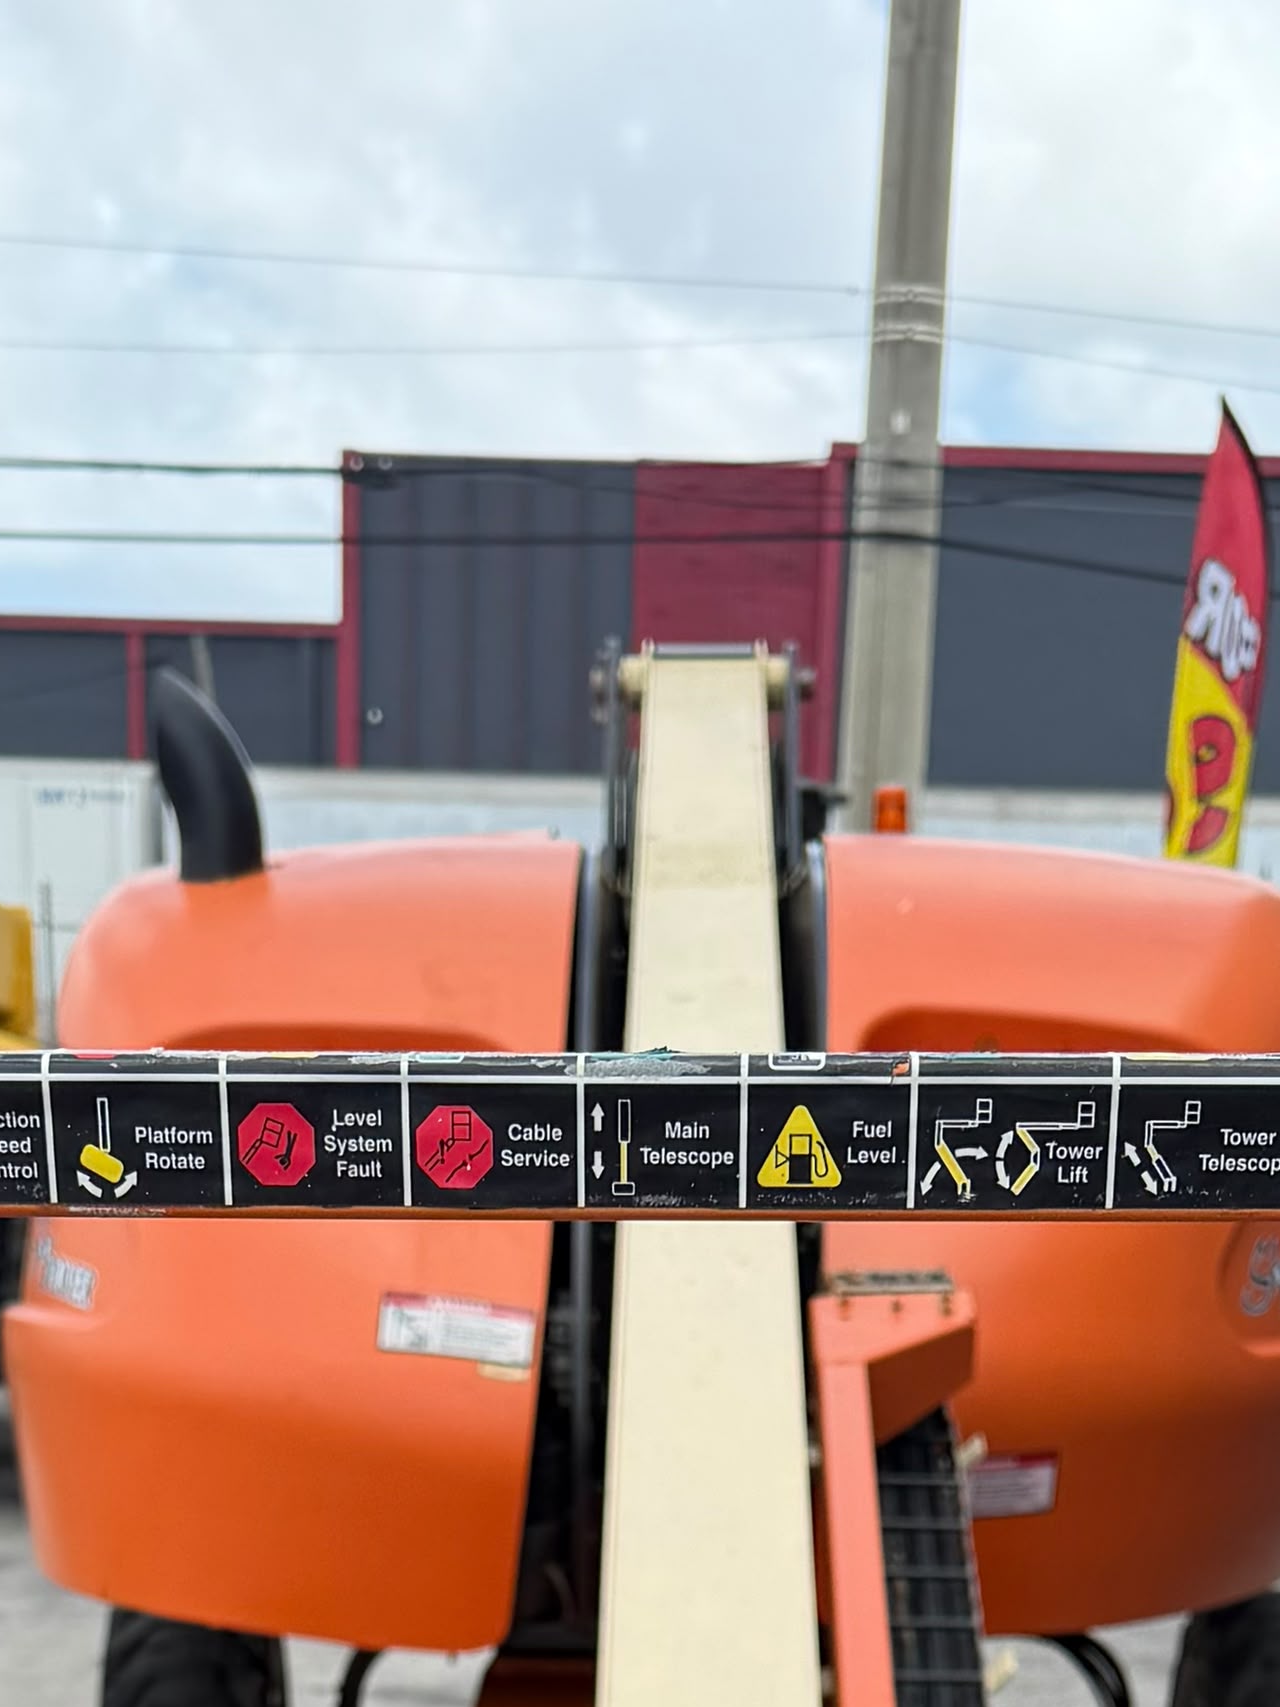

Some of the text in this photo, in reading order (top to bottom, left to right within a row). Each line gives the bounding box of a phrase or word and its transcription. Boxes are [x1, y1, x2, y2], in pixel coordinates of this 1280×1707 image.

[332, 1110, 381, 1129] Level
[135, 1127, 212, 1143] Platform
[509, 1124, 562, 1141] Cable
[666, 1122, 709, 1138] Main
[853, 1121, 891, 1137] Fuel
[1221, 1129, 1276, 1145] Tower
[324, 1135, 392, 1156] System
[1046, 1142, 1103, 1159] Tower
[146, 1152, 204, 1169] Rotate
[502, 1150, 569, 1166] Service
[640, 1147, 733, 1168] Telescope
[848, 1147, 896, 1163] Level
[337, 1161, 381, 1177] Fault
[1058, 1166, 1088, 1183] Lift
